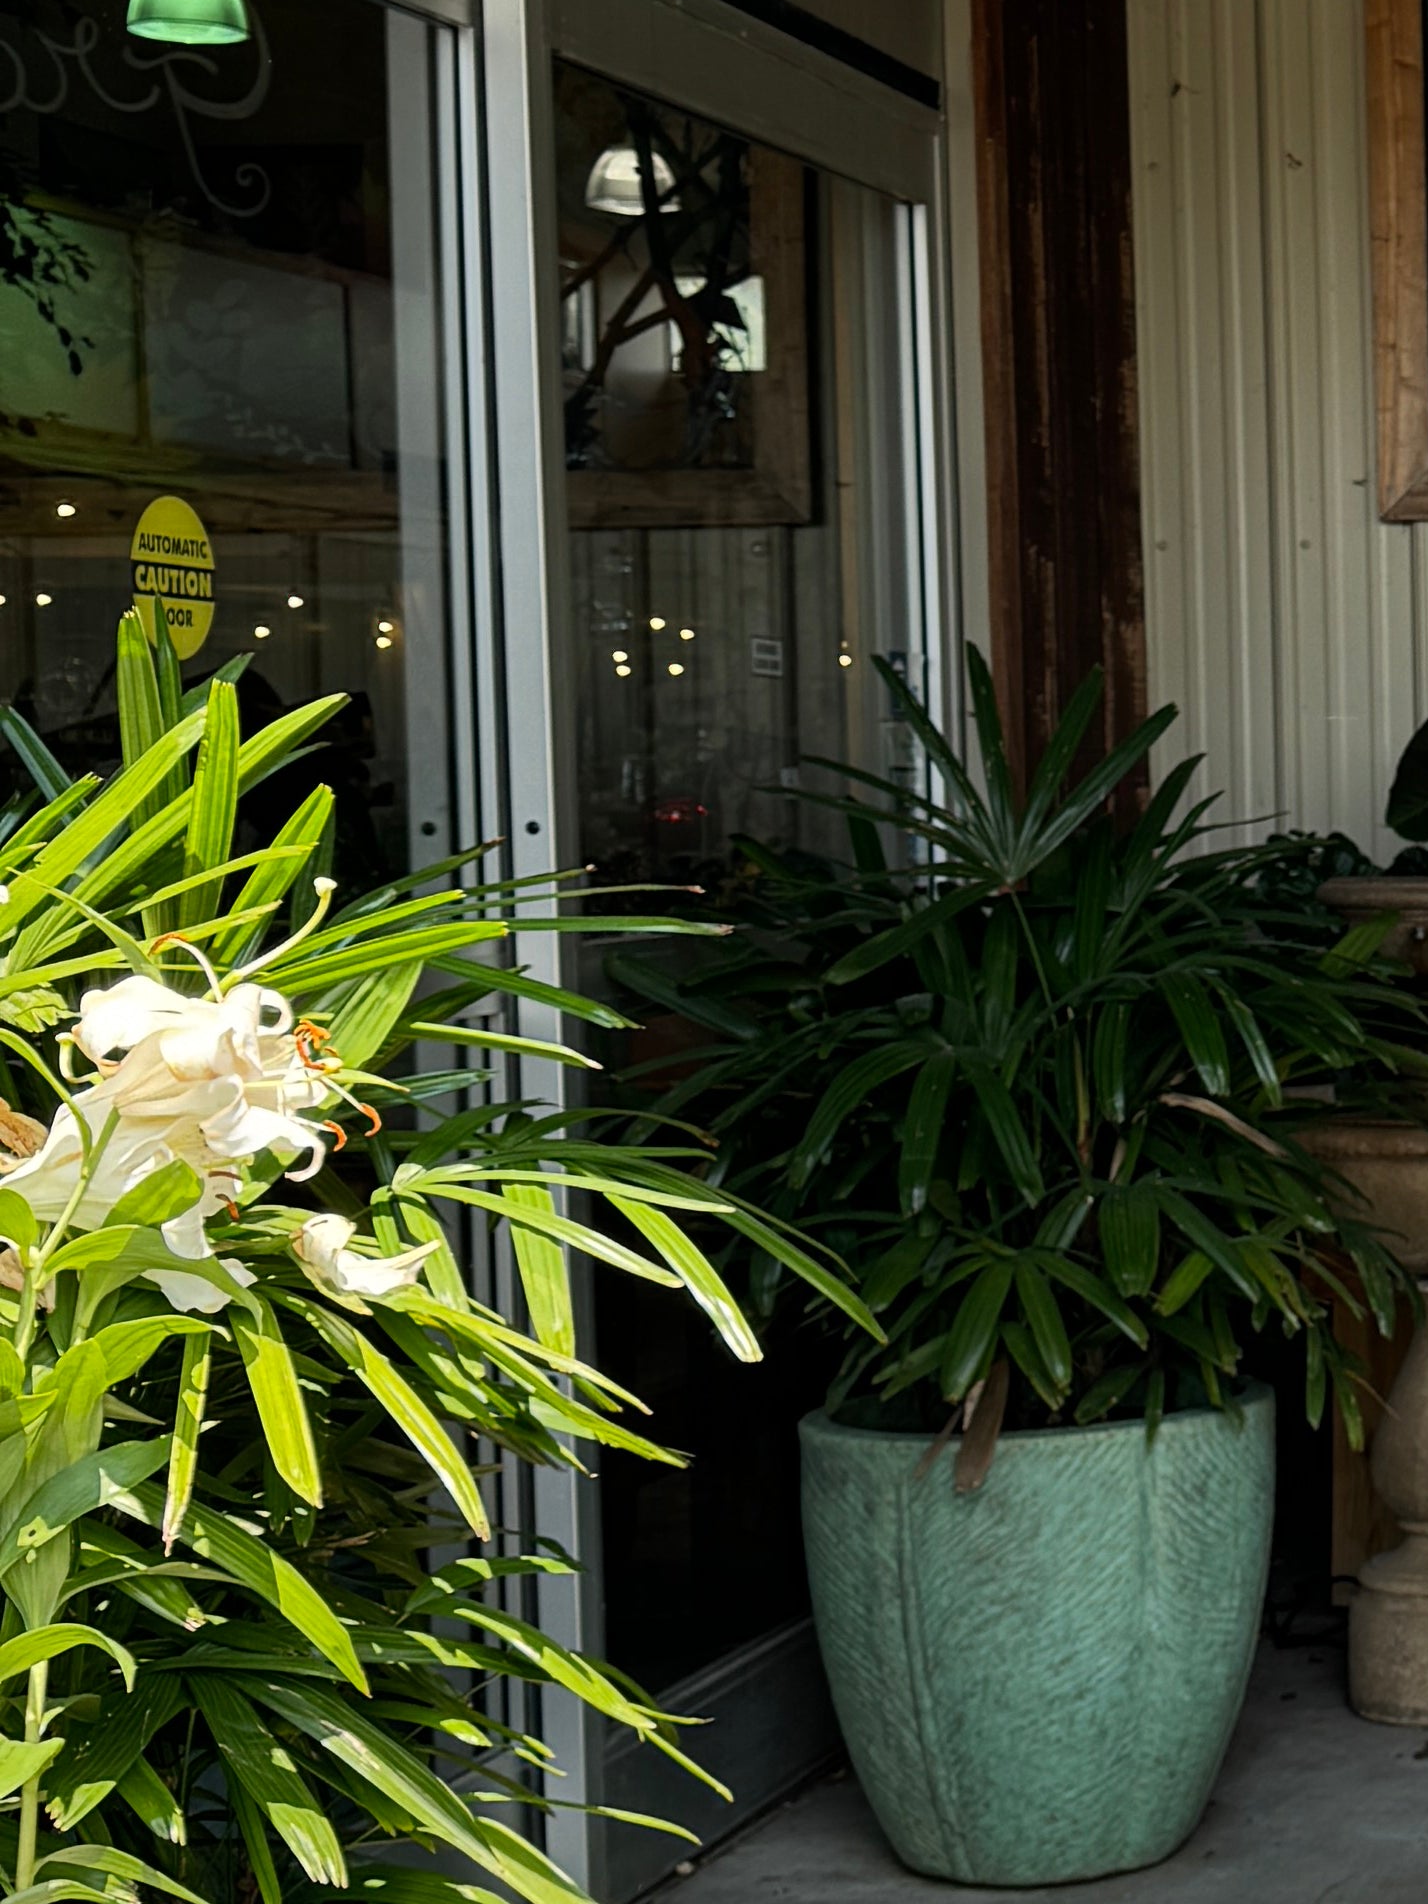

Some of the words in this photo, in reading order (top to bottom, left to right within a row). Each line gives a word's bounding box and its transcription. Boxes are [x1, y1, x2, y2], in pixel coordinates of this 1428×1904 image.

[138, 532, 208, 559] AUTOMATIC
[134, 564, 212, 598] CAUTION
[166, 607, 194, 628] OOR
